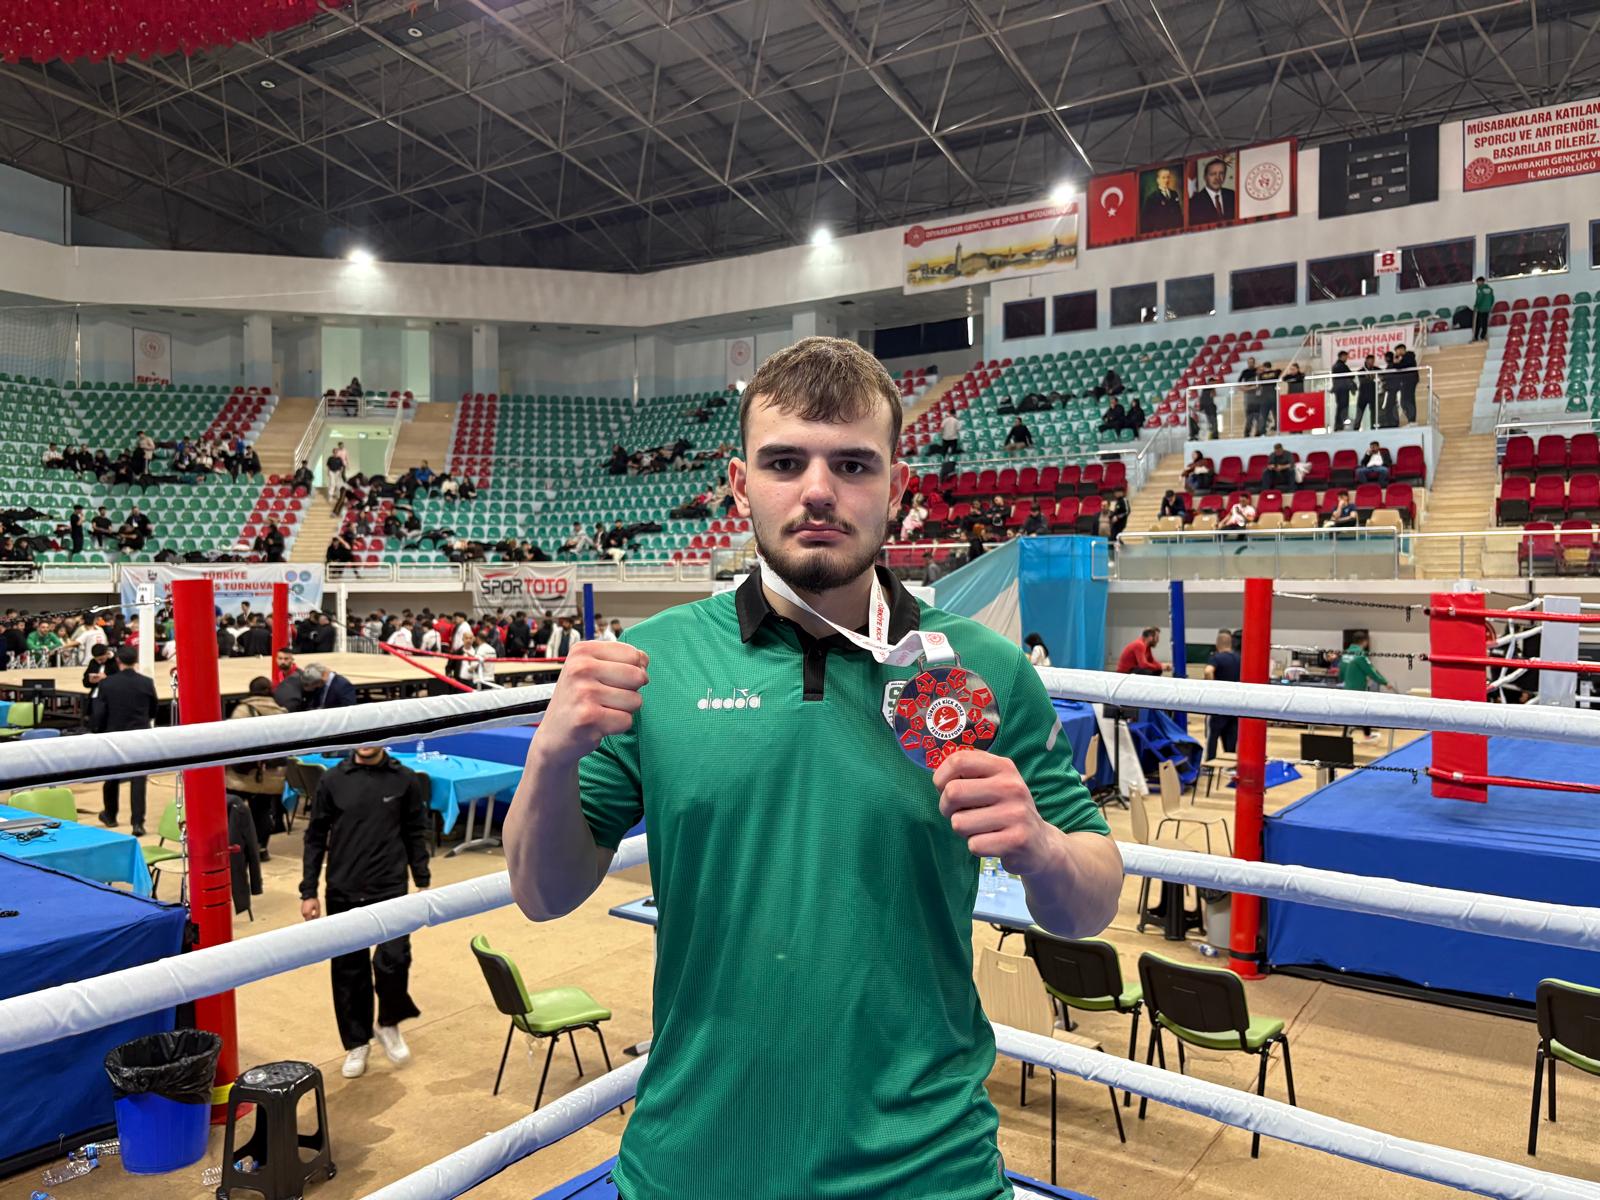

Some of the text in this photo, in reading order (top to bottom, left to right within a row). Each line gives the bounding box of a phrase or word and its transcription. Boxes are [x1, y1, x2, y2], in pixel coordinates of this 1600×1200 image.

[1467, 103, 1600, 135] MÜSABAKALARA KATILAN
[1474, 132, 1516, 148] SPORCU
[1520, 129, 1532, 140] VE
[1493, 141, 1551, 160] BAŞARILAR
[1498, 158, 1550, 173] DİYARBAKIR
[1551, 151, 1590, 166] GENÇLİK
[1528, 161, 1596, 179] İL MÜDÜRLÜĞÜ
[1382, 253, 1395, 267] B
[1335, 331, 1403, 347] YEMEKHANE
[202, 570, 246, 580] TÜRKİYE
[224, 582, 273, 591] TURNUVA
[697, 687, 761, 709] diadora
